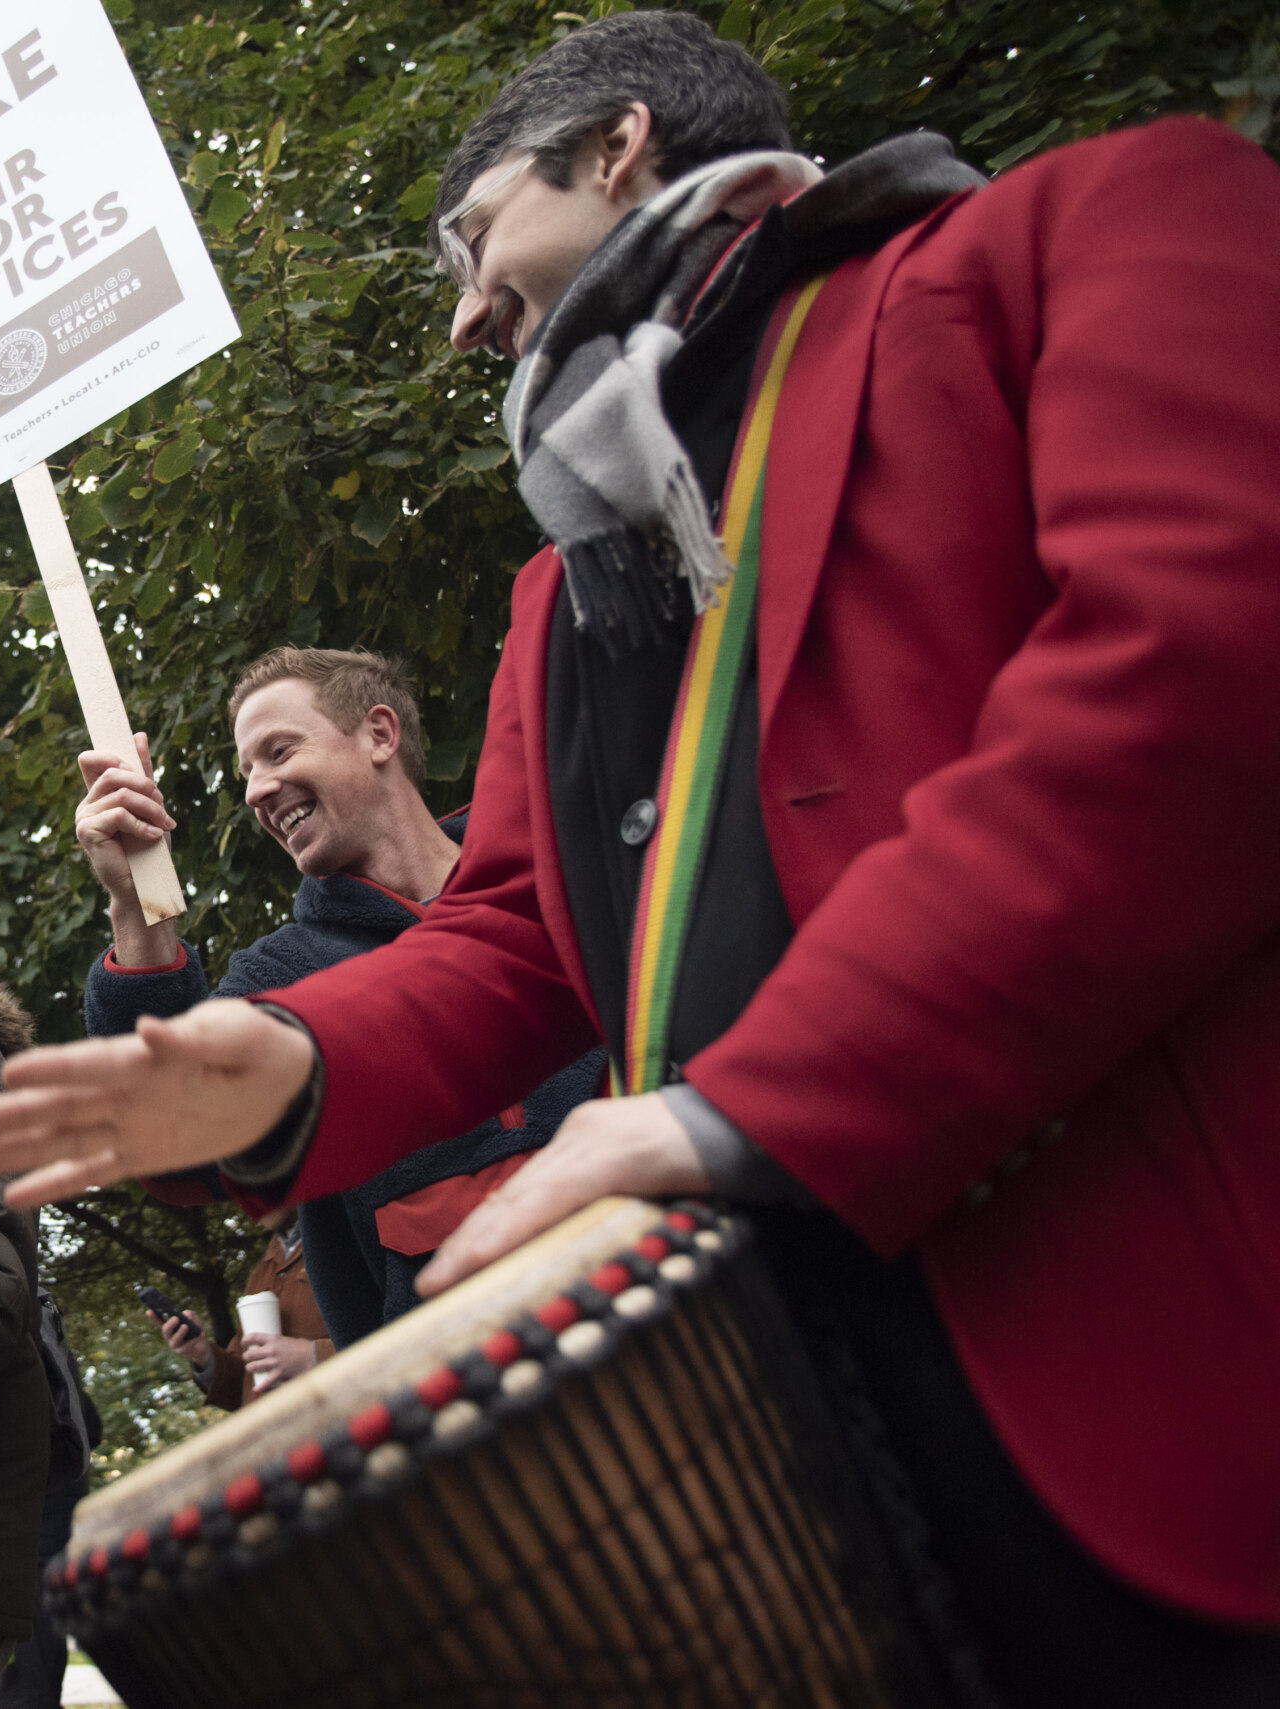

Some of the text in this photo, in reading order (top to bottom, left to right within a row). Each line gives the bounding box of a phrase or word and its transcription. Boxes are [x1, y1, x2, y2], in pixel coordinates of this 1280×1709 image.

[48, 268, 131, 327] CHICAGO
[52, 277, 142, 340] TEACHERS
[57, 311, 117, 355] UNION
[2, 409, 52, 444] Teachers
[61, 382, 93, 407] Local
[95, 373, 102, 386] 1
[112, 340, 160, 377] AFL-CIO
